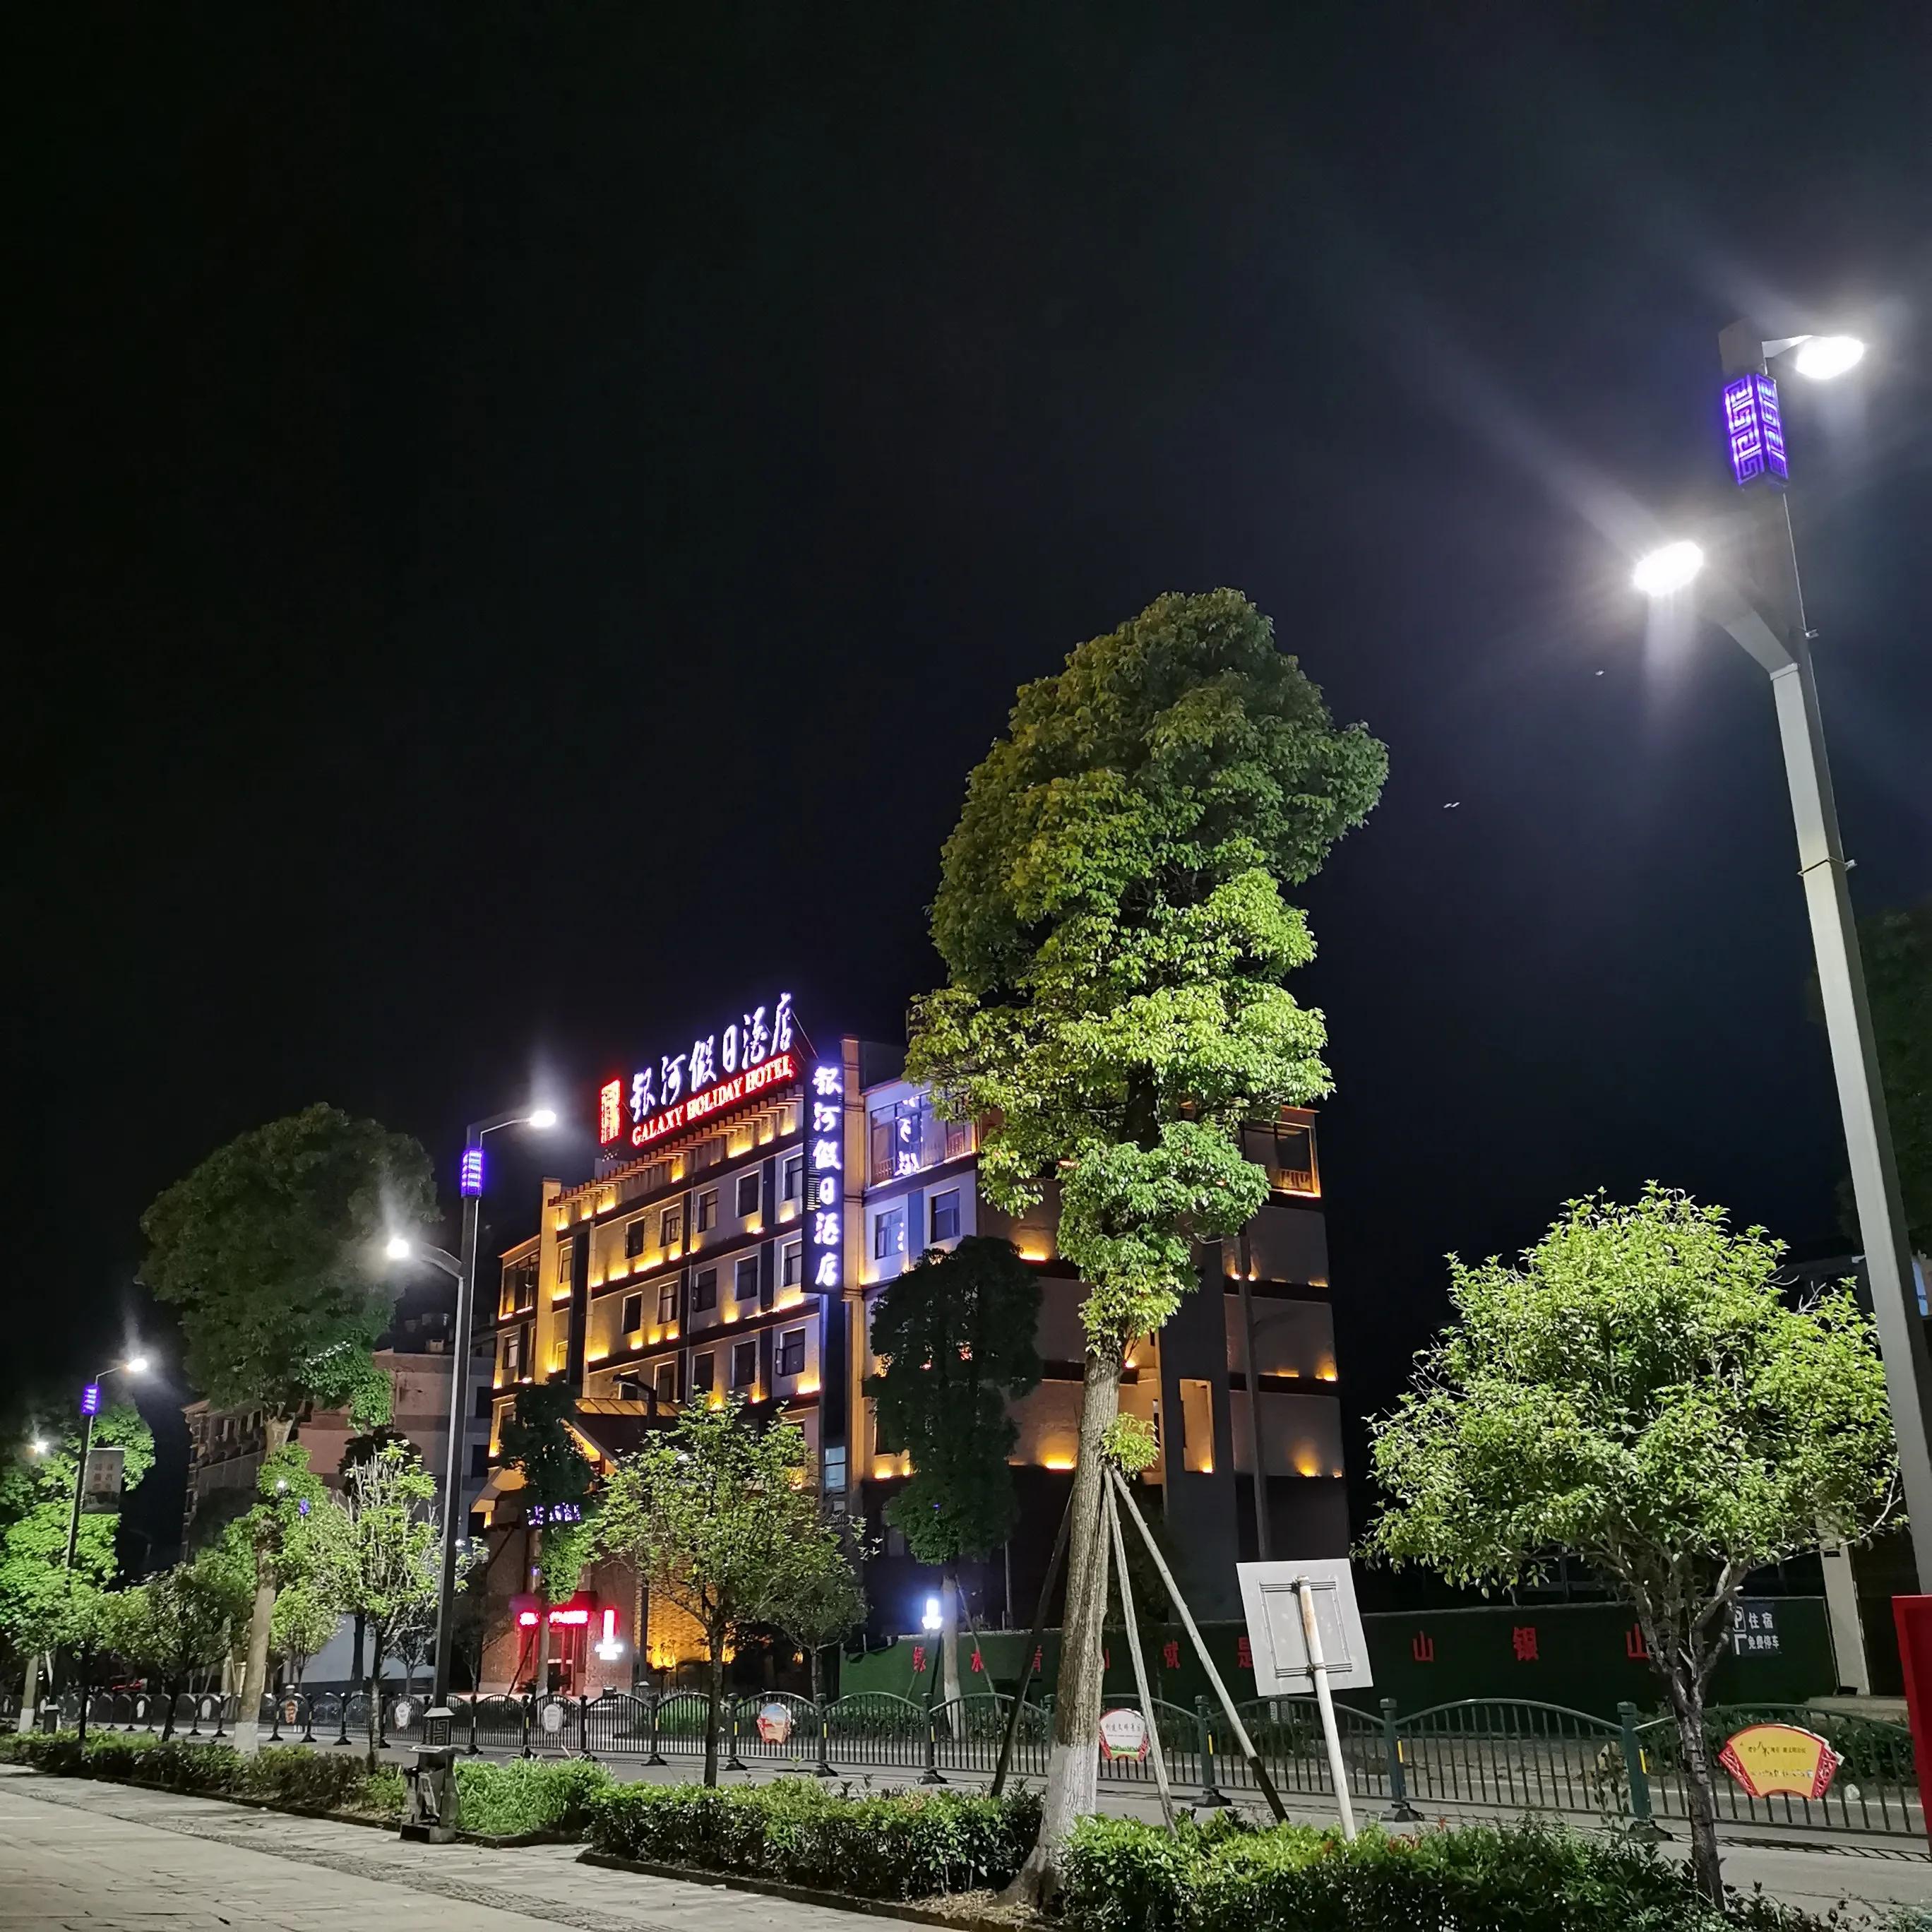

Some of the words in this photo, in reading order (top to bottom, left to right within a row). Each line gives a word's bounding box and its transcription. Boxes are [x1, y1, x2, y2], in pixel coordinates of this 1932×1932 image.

[630, 993, 792, 1123] 银河假日酒店
[632, 1104, 684, 1146] GALAXY
[686, 1076, 744, 1121] HOLIDAY
[745, 1054, 794, 1094] HOTEL
[812, 1066, 842, 1287] 银河假日酒店
[1748, 1611, 1773, 1630] 住宿
